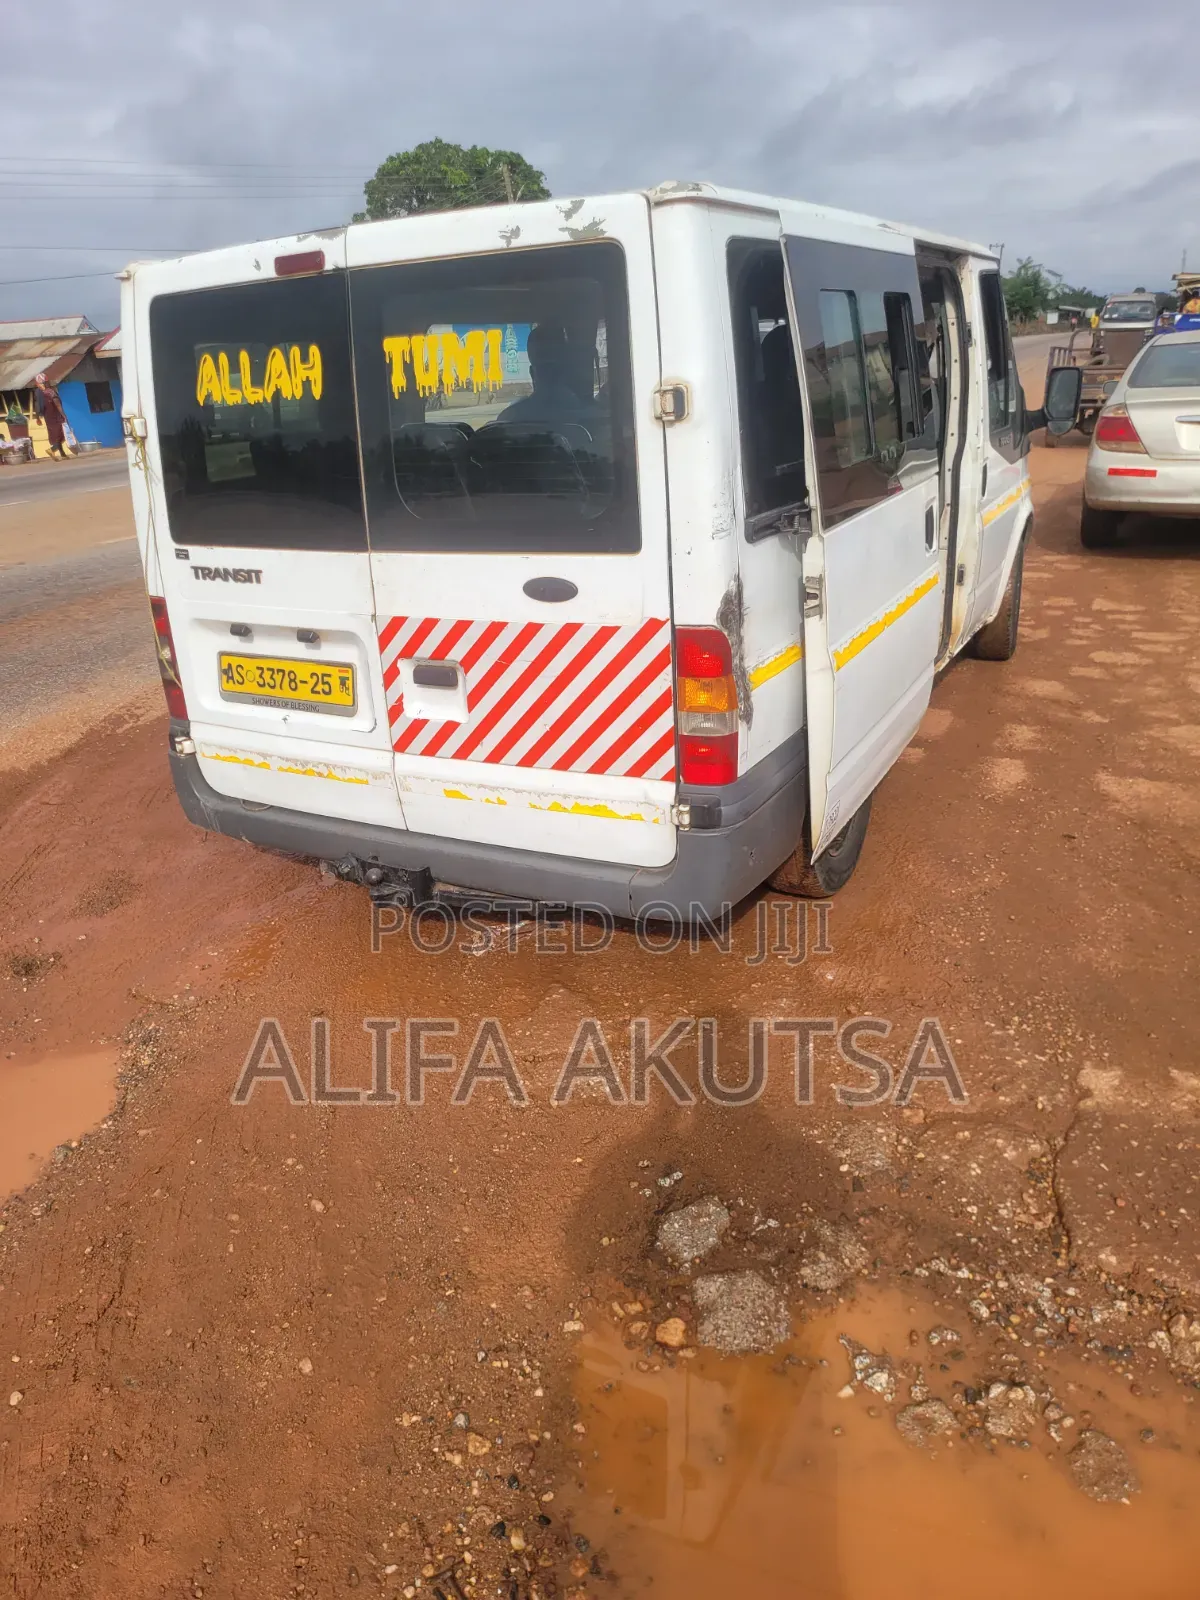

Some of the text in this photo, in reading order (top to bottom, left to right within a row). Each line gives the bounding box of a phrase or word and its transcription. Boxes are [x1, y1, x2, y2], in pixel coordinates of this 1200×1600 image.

[196, 329, 503, 406] ALLAH TUMI
[190, 566, 263, 584] TRANSIT
[226, 662, 332, 695] AS 3378-25
[252, 697, 280, 708] SHOWERS
[290, 702, 320, 712] BLESSING
